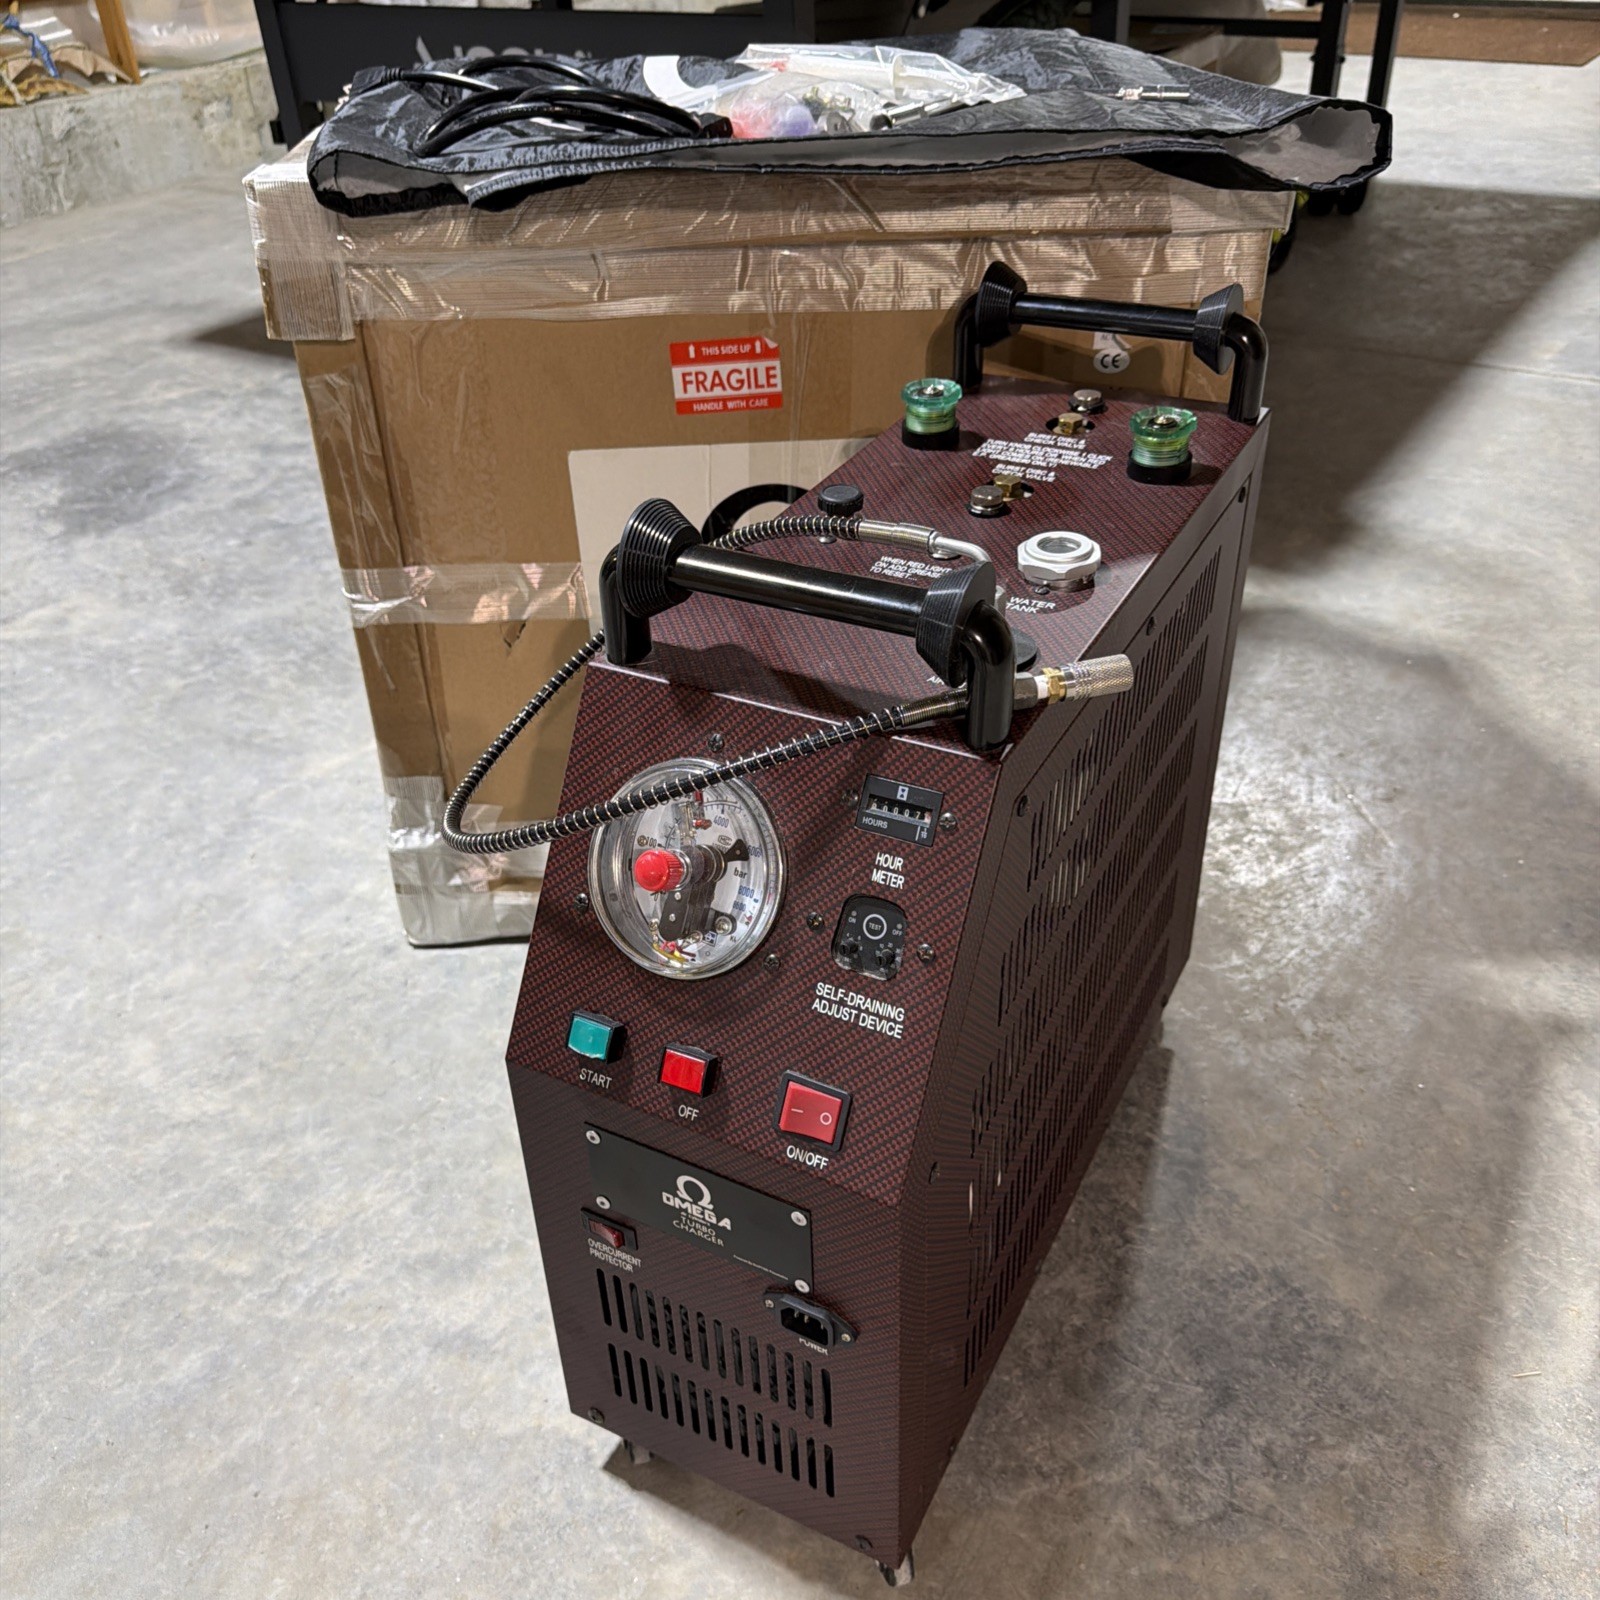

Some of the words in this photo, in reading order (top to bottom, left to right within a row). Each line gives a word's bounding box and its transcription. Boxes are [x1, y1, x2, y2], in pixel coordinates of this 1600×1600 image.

[701, 347, 720, 356] THIS
[720, 345, 739, 355] SIDE
[740, 344, 752, 354] UP
[681, 366, 778, 394] FRAGILE
[693, 401, 723, 412] HANDLE
[727, 399, 746, 410] WITH
[749, 397, 769, 407] CARE
[870, 565, 883, 573] TO
[874, 561, 889, 569] ON
[888, 564, 908, 572] ADD
[880, 556, 907, 565] WHEN
[906, 561, 926, 569] RED
[925, 565, 953, 573] LIGHT
[1005, 602, 1040, 614] TANK
[1010, 596, 1056, 610] WATER
[862, 816, 888, 829] HOURS
[875, 852, 904, 871] HOUR
[733, 867, 748, 879] bar
[871, 868, 905, 890] METER
[848, 916, 857, 924] ON
[868, 922, 882, 931] TEST
[815, 982, 905, 1022] SELF-DRAINING
[811, 998, 858, 1023] ADJUST
[858, 1012, 904, 1039] DEVICE
[579, 1067, 612, 1090] START
[678, 1104, 699, 1121] OFF
[786, 1145, 829, 1170] ON/OFF
[662, 1192, 732, 1231] OMEGA
[672, 1219, 725, 1247] CHARGER
[680, 1215, 716, 1236] TURBO
[587, 1237, 642, 1268] OVERCURRENT
[589, 1247, 634, 1273] PROTECTOR
[798, 1337, 829, 1356] POWER
